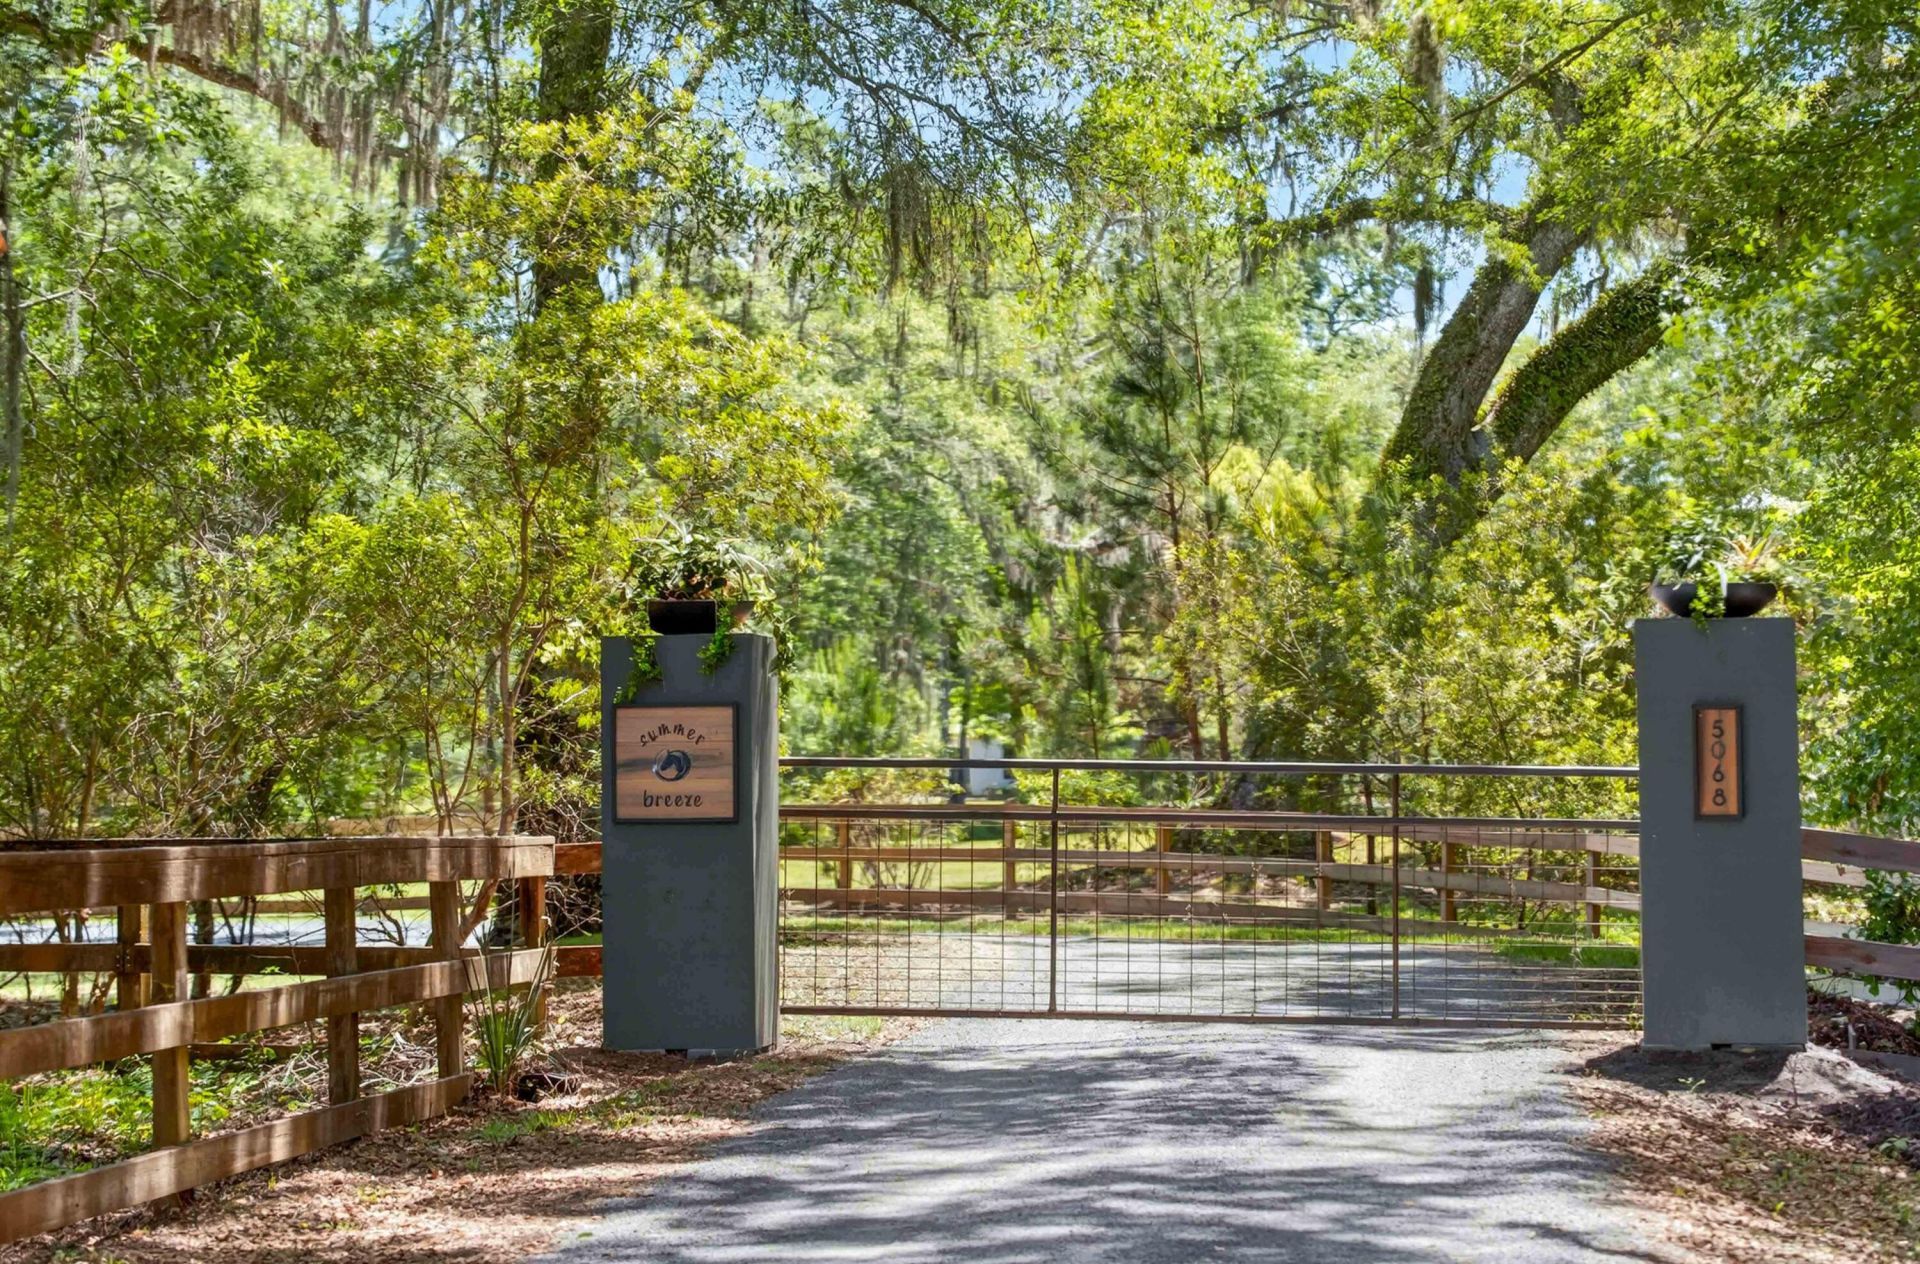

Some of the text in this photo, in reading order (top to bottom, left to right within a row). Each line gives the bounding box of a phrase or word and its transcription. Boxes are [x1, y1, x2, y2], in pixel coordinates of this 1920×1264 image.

[640, 723, 705, 747] summer
[1711, 719, 1726, 807] 5068
[643, 789, 703, 808] breeze
